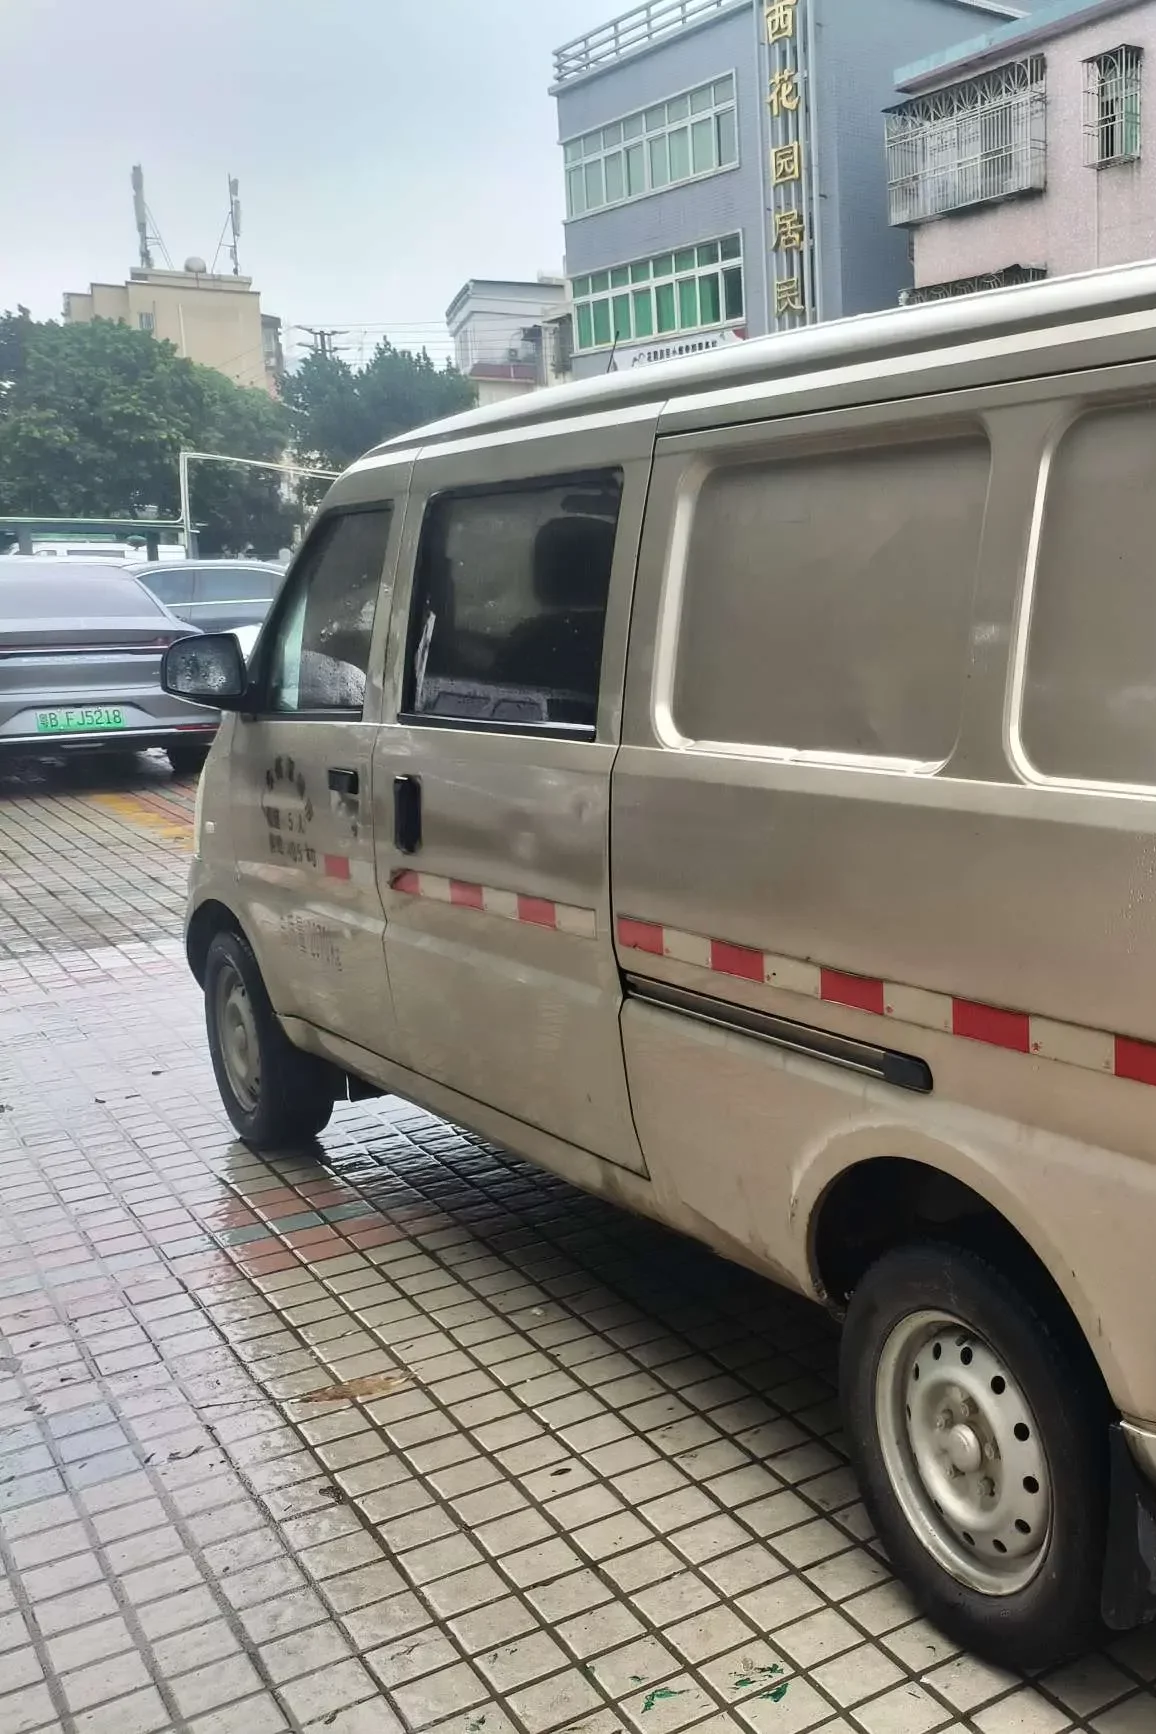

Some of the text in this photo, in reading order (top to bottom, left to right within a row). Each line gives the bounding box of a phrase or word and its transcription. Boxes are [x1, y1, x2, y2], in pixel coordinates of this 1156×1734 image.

[765, 0, 805, 316] 西花园居民
